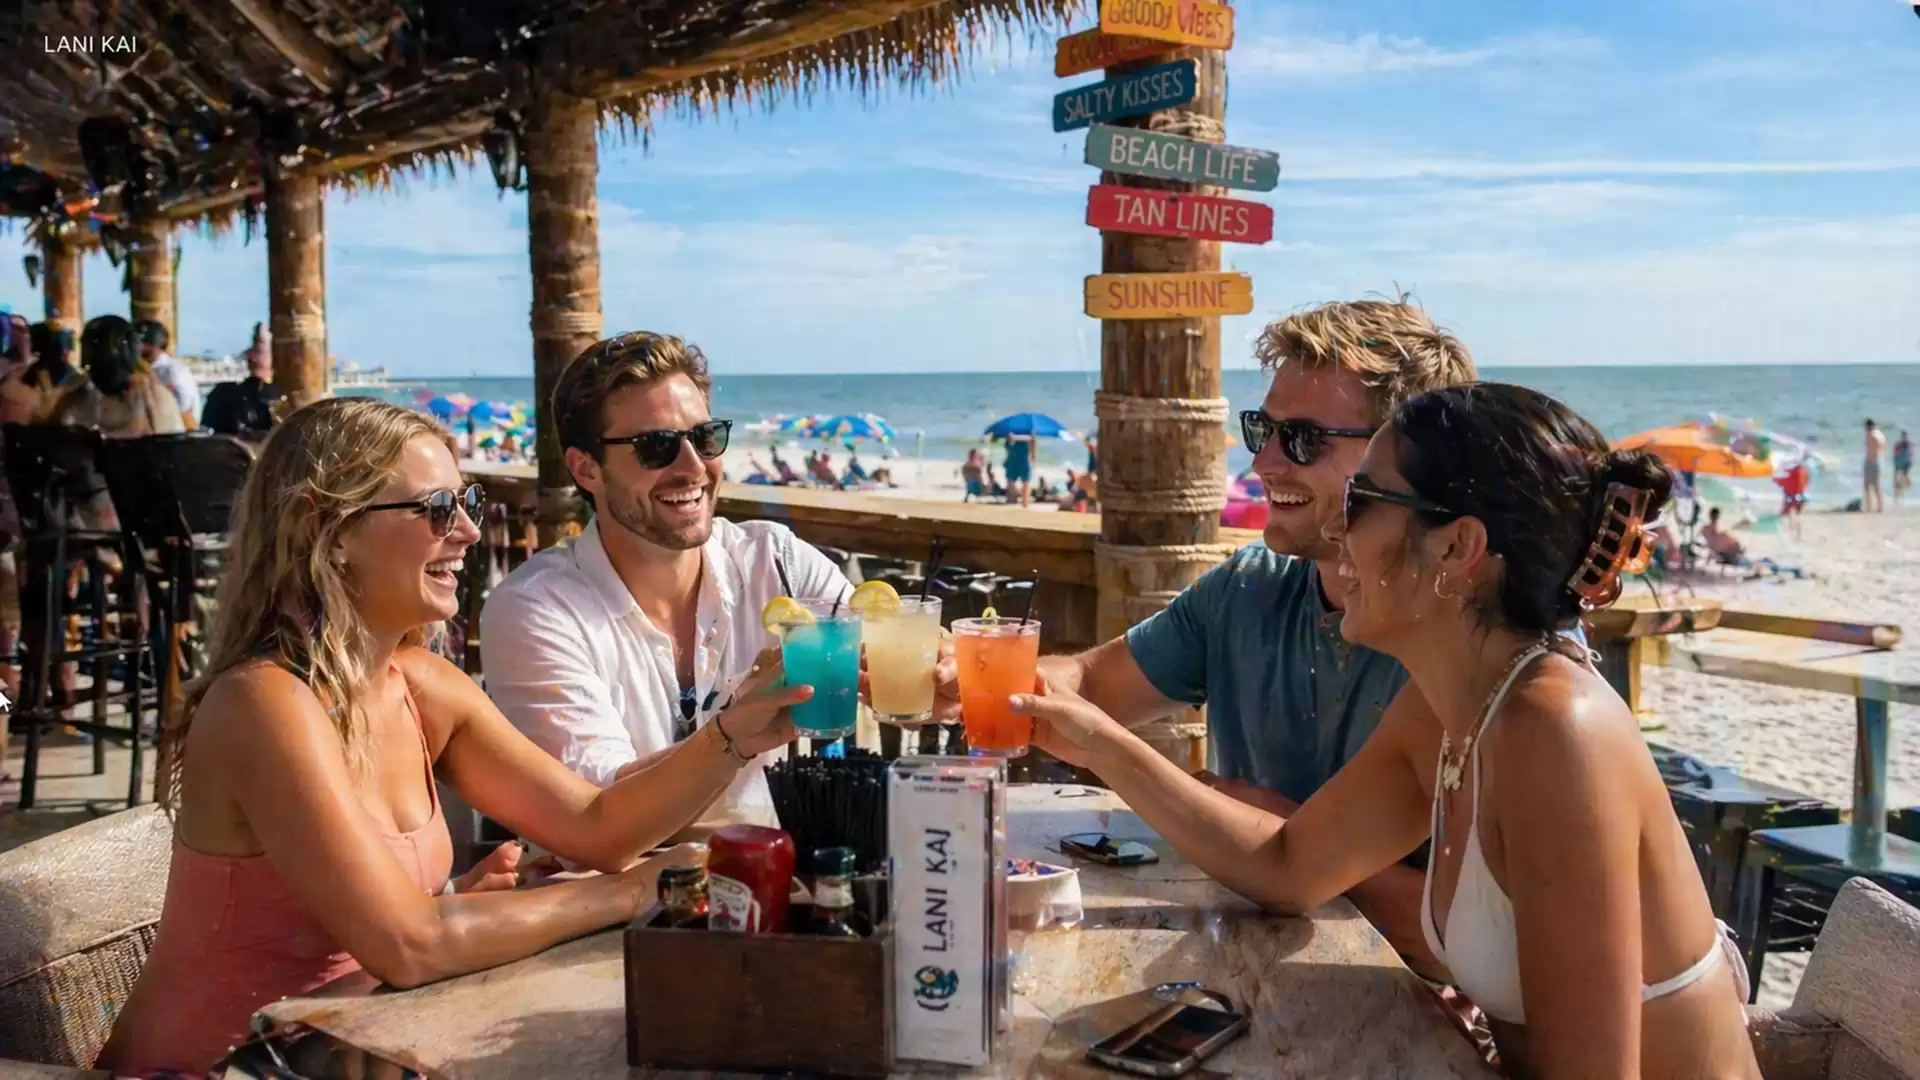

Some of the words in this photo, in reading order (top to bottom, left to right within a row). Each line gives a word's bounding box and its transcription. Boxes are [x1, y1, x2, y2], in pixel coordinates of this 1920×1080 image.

[1063, 82, 1116, 124] SALTY
[1122, 68, 1185, 108] KISSES
[1109, 133, 1195, 174] BEACH
[1204, 149, 1260, 184] LIFE
[1113, 193, 1166, 228] TAN
[1175, 200, 1249, 237] LINES
[1107, 279, 1232, 311] SUNSHINE
[922, 887, 948, 953] LANI
